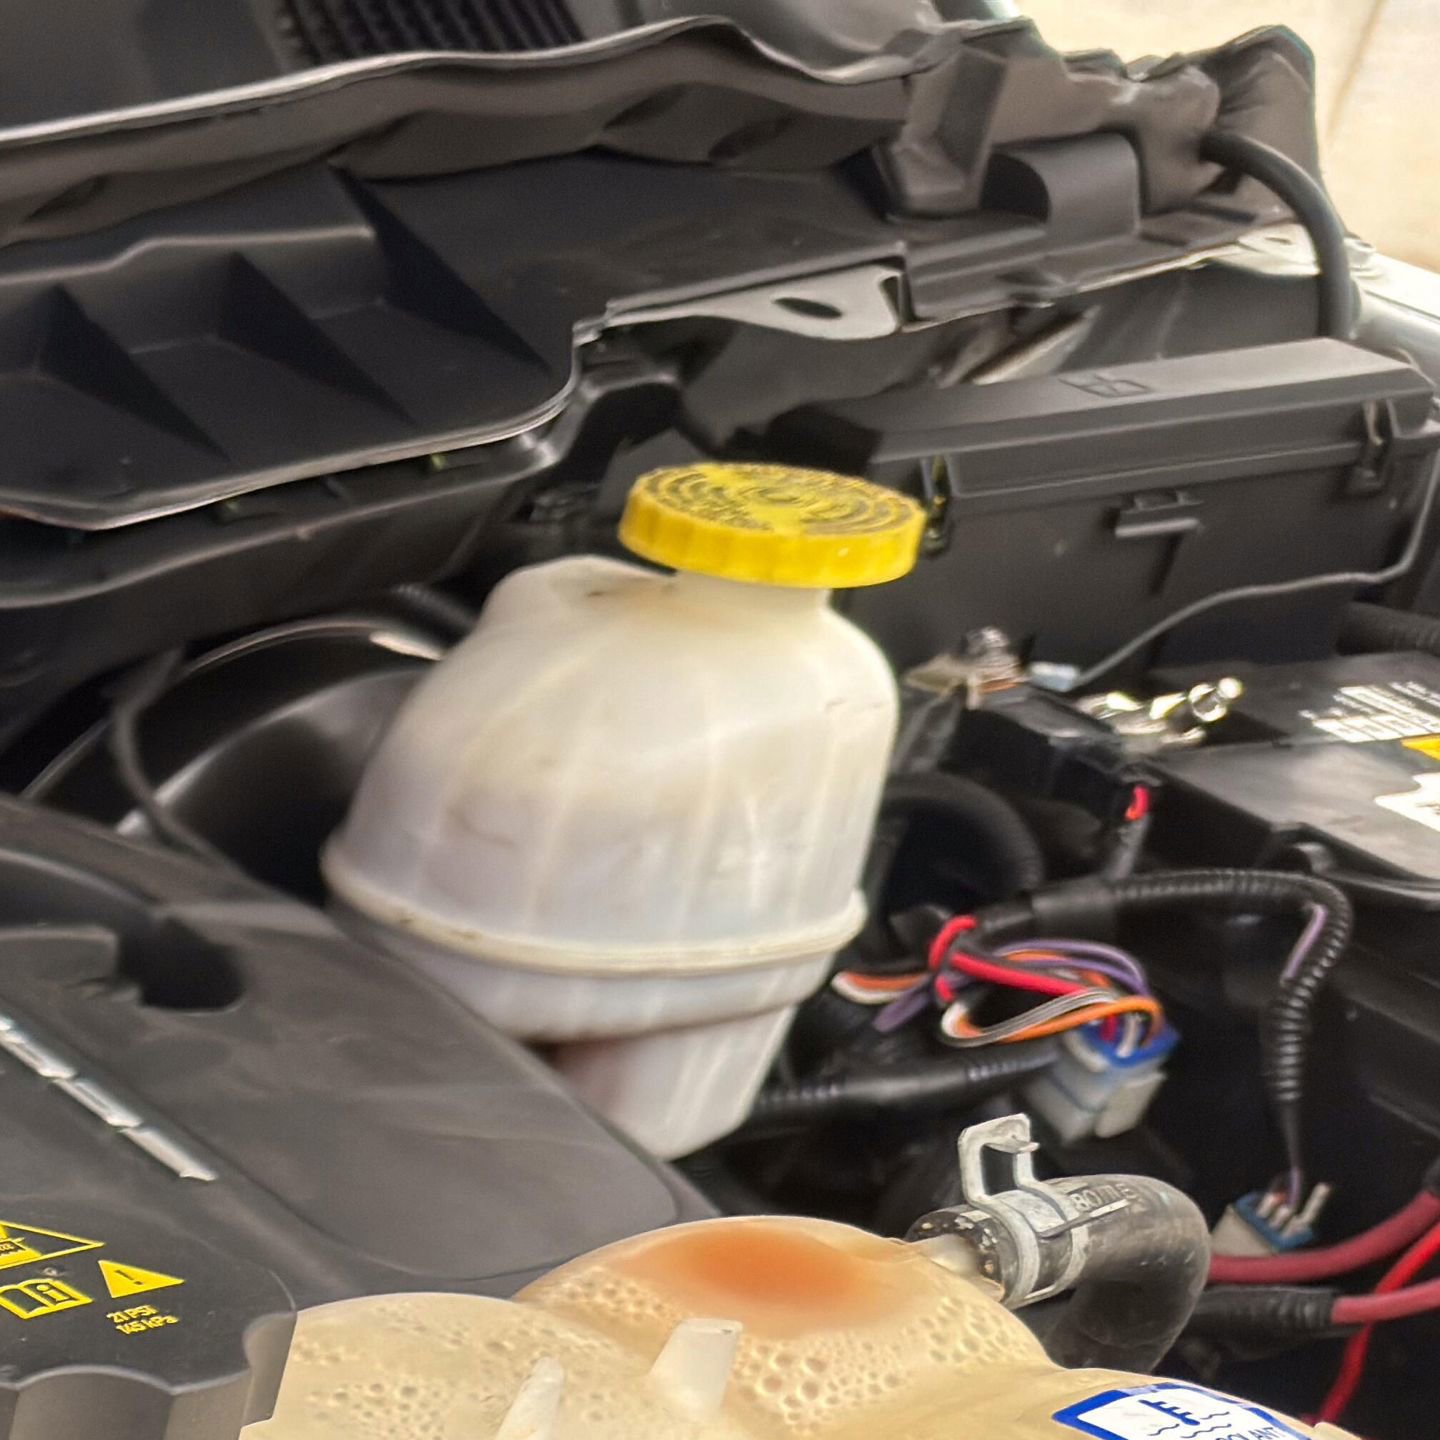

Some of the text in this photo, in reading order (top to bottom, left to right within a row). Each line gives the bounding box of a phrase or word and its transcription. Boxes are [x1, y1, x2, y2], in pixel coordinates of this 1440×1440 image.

[106, 1304, 159, 1323] 21 PSI
[115, 1315, 179, 1335] 145 kPa
